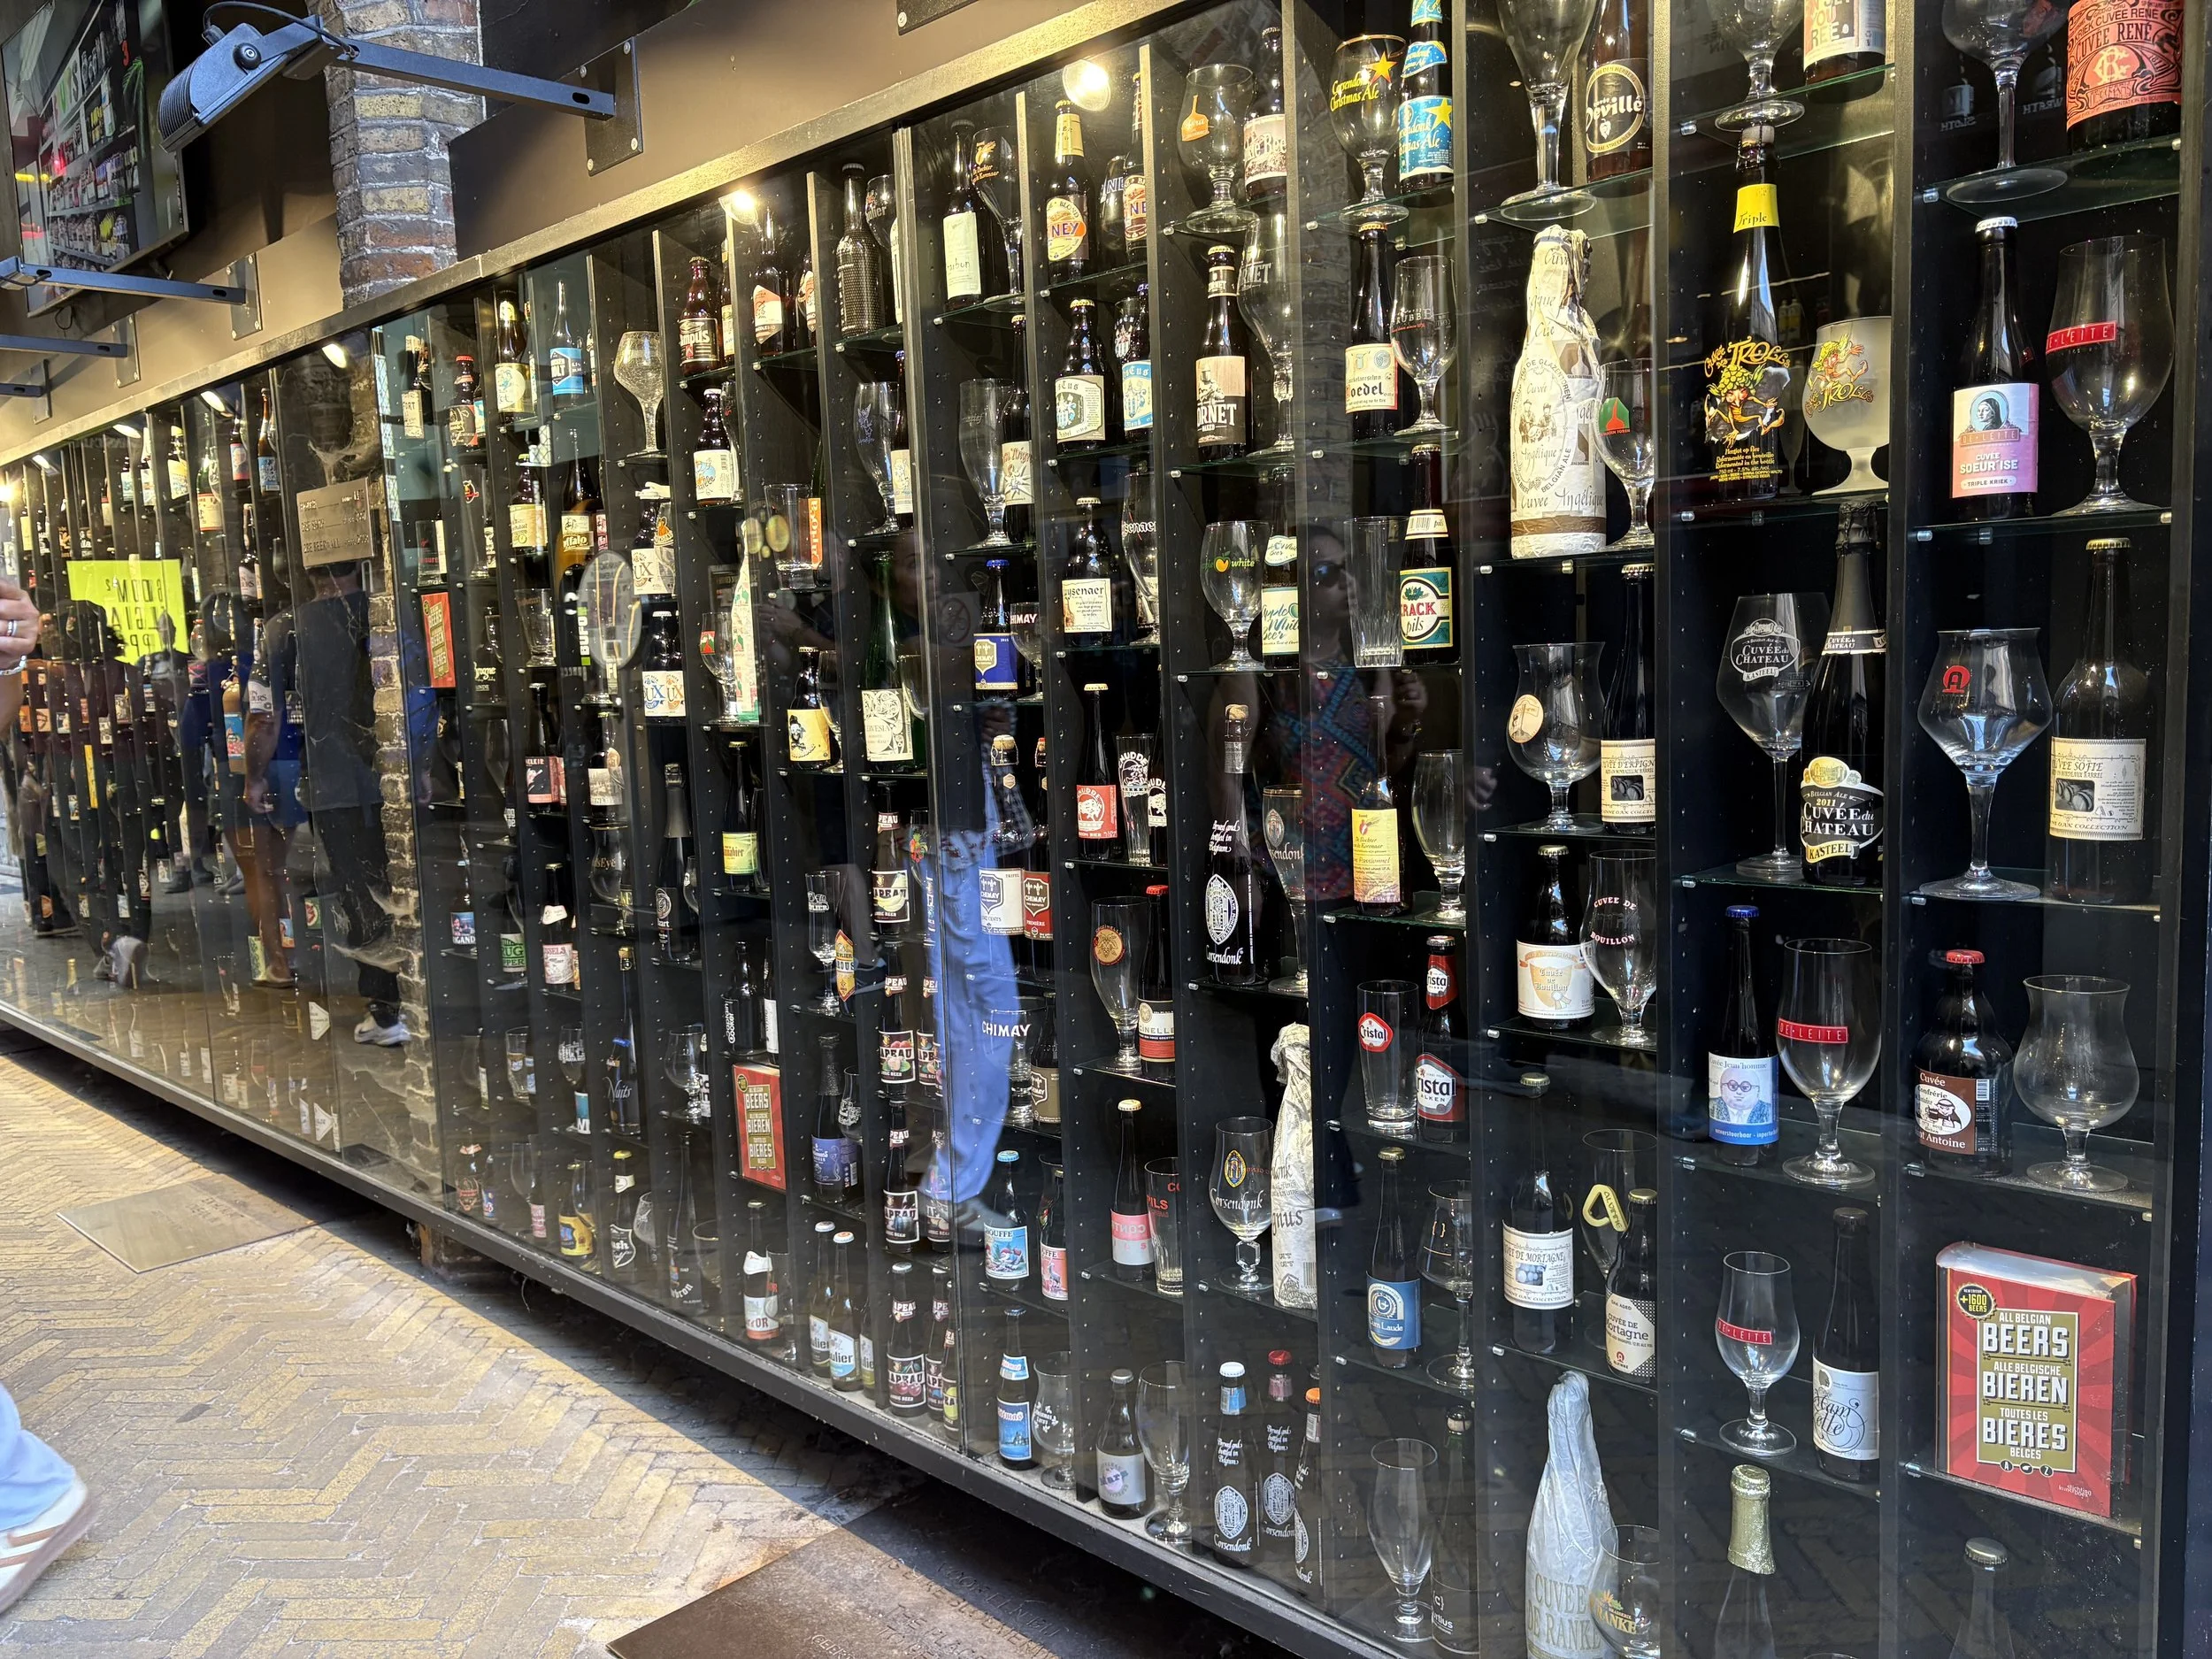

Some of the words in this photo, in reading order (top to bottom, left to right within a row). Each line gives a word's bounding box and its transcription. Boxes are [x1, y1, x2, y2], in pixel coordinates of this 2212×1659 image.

[2095, 9, 2128, 26] CUVEE
[2131, 7, 2158, 19] RENE
[2076, 27, 2110, 64] CUVÉE
[2116, 22, 2152, 42] RENÉ
[1331, 89, 1362, 111] Christmas
[1361, 83, 1379, 102] Ale
[1264, 132, 1286, 156] Bee
[1421, 133, 1440, 148] Ale
[1059, 200, 1079, 218] BLOND
[1736, 211, 1768, 227] Triple
[1051, 222, 1079, 238] NEY
[680, 327, 710, 347] ampus
[2061, 326, 2108, 344] LEITE
[1727, 335, 1791, 368] TROLLS
[1976, 452, 2001, 461] CUVÉE
[1541, 465, 1565, 493] BELGIAN
[1555, 485, 1604, 517] Angélique
[1433, 518, 1444, 528] pils
[563, 535, 588, 549] ffalo
[1232, 557, 1255, 568] white
[1064, 586, 1104, 600] ysenaer
[1401, 602, 1436, 617] RACK
[1406, 617, 1425, 637] pils
[1742, 643, 1782, 656] CUVÉE
[1735, 654, 1789, 665] CHATEAU
[1746, 669, 1776, 680] KASTEEL
[2074, 762, 2103, 772] SOFIE
[1804, 802, 1861, 820] CUVÉE
[1862, 810, 1874, 820] du
[878, 813, 898, 826] PEAU
[1801, 815, 1874, 835] CHATEAU
[1809, 843, 1852, 860] KASTEEL
[873, 887, 907, 899] APEAU
[1025, 895, 1046, 903] CHIMAY
[1594, 896, 1620, 908] CUVEE
[1623, 900, 1637, 910] DE
[1590, 931, 1635, 945] BOUILLON
[1206, 944, 1242, 965] Corsendonk
[1427, 976, 1450, 987] ristal
[982, 1020, 1033, 1037] CHIMAY
[1360, 1025, 1386, 1041] Cristal
[1779, 1021, 1792, 1035] DE
[1798, 1027, 1843, 1041] LEITE
[880, 1048, 912, 1059] APEAU
[1919, 1072, 1946, 1087] Cuvée
[604, 1076, 632, 1102] Nuits
[745, 1093, 769, 1110] BEERS
[748, 1118, 771, 1133] BIEREN
[1926, 1133, 1965, 1148] Antoine
[749, 1143, 772, 1158] BIERES
[1210, 1187, 1263, 1210] Corsendonk
[886, 1209, 916, 1219] APEAU
[1271, 1209, 1303, 1237] gnus
[1516, 1252, 1524, 1261] DE
[1525, 1251, 1564, 1263] MORTAGNE
[1960, 1294, 1987, 1306] +1600
[1968, 1304, 1987, 1313] BEERS
[1609, 1312, 1627, 1326] CUVÉE
[2000, 1312, 2015, 1323] ALL
[2016, 1313, 2051, 1325] BELGIAN
[1381, 1322, 1403, 1332] Laude
[1732, 1330, 1768, 1343] LEITE
[1983, 1323, 2070, 1359] BEERS
[832, 1352, 853, 1363] ulier
[1993, 1361, 2014, 1371] ALLE
[2016, 1363, 2061, 1377] BELGISCHE
[888, 1372, 923, 1384] APEAU
[1983, 1371, 2069, 1406] BIEREN
[2000, 1408, 2031, 1419] TOUTES
[2033, 1409, 2048, 1422] LES
[1983, 1417, 2068, 1451] BIERES
[2010, 1448, 2041, 1460] BELGES
[1263, 1521, 1295, 1538] Corsendon
[1213, 1534, 1252, 1552] Corsendonk
[1528, 1601, 1540, 1639] DE
[1547, 1612, 1602, 1650] RANKE
[1596, 1610, 1637, 1634] RANKE
